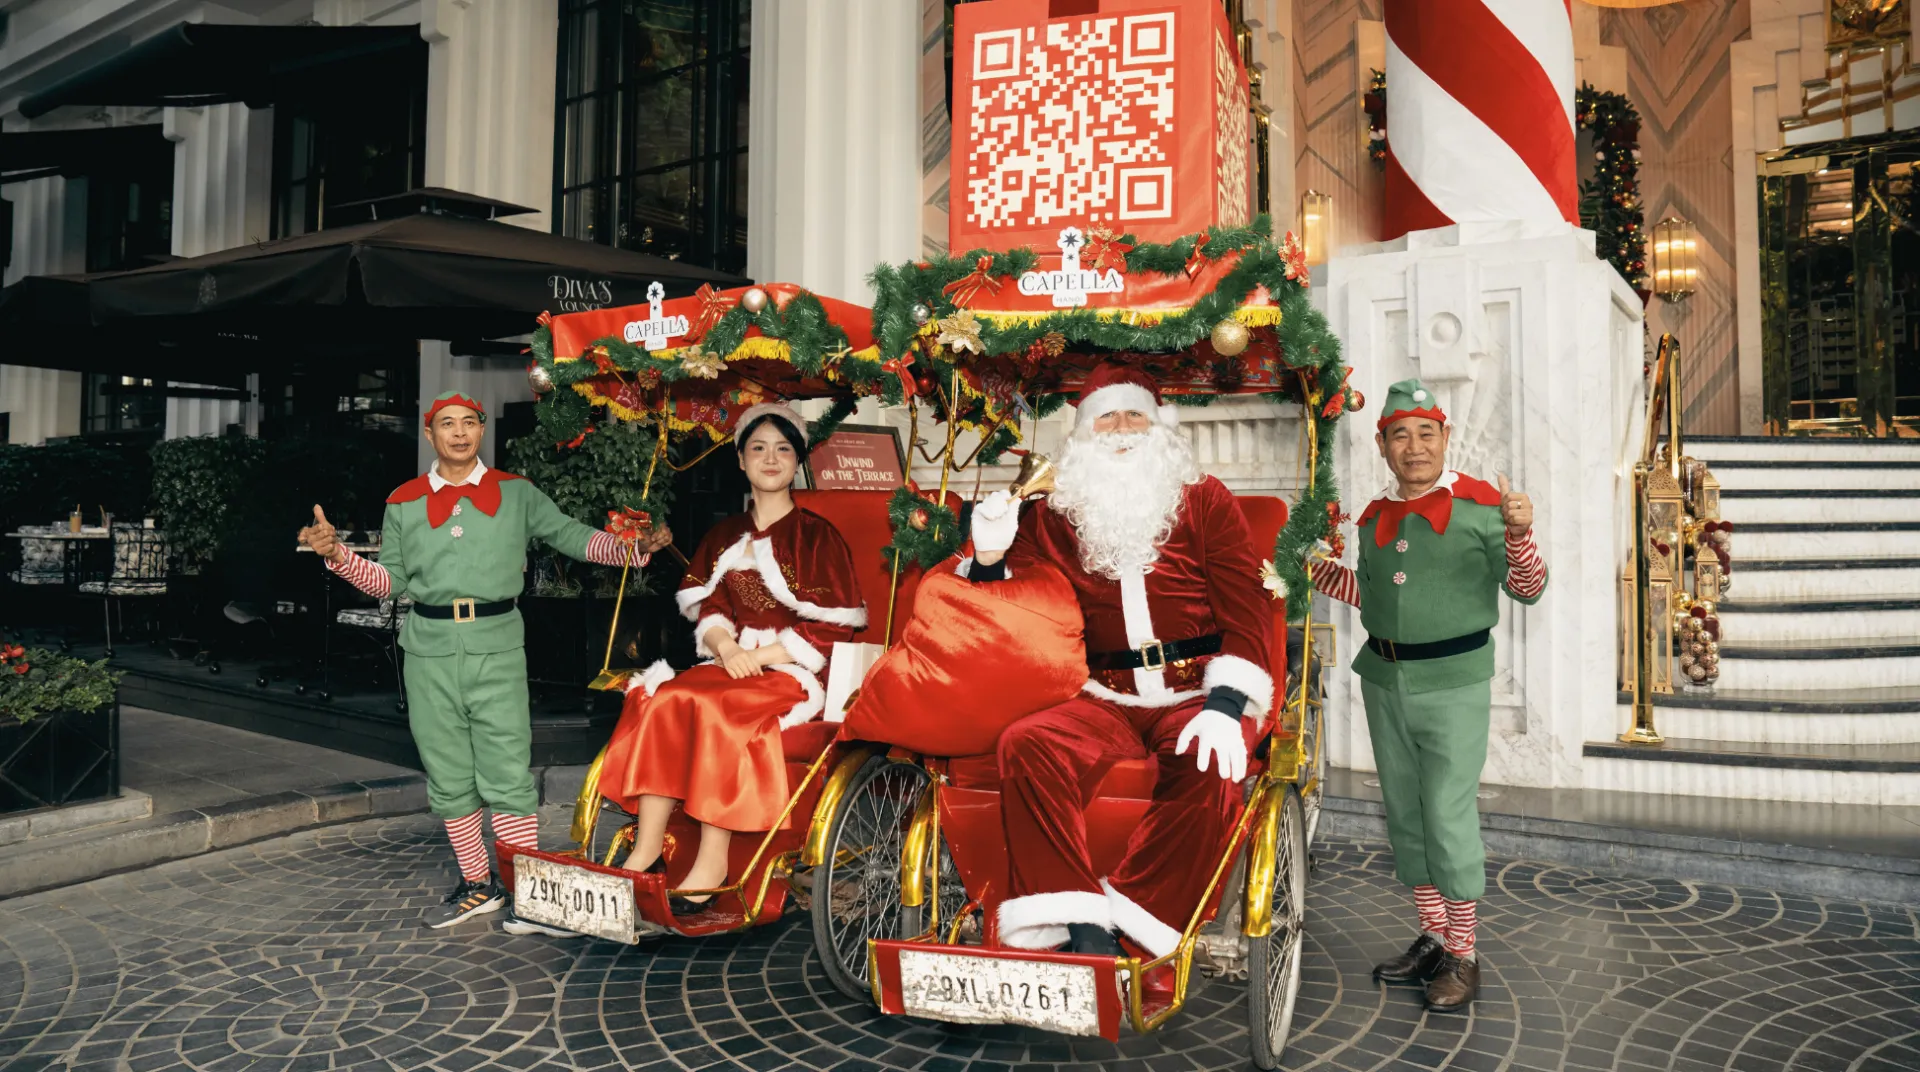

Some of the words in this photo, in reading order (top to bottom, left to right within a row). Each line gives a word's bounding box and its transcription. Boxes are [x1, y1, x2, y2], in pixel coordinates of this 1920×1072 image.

[547, 275, 612, 304] DIVA'S
[1021, 273, 1119, 292] CAPELLA
[625, 319, 686, 340] CAPELLA
[836, 454, 874, 469] UNWIND
[821, 470, 836, 481] ON
[836, 470, 855, 481] THE
[855, 469, 895, 484] TERRACE
[528, 876, 619, 919] 29XL-0011
